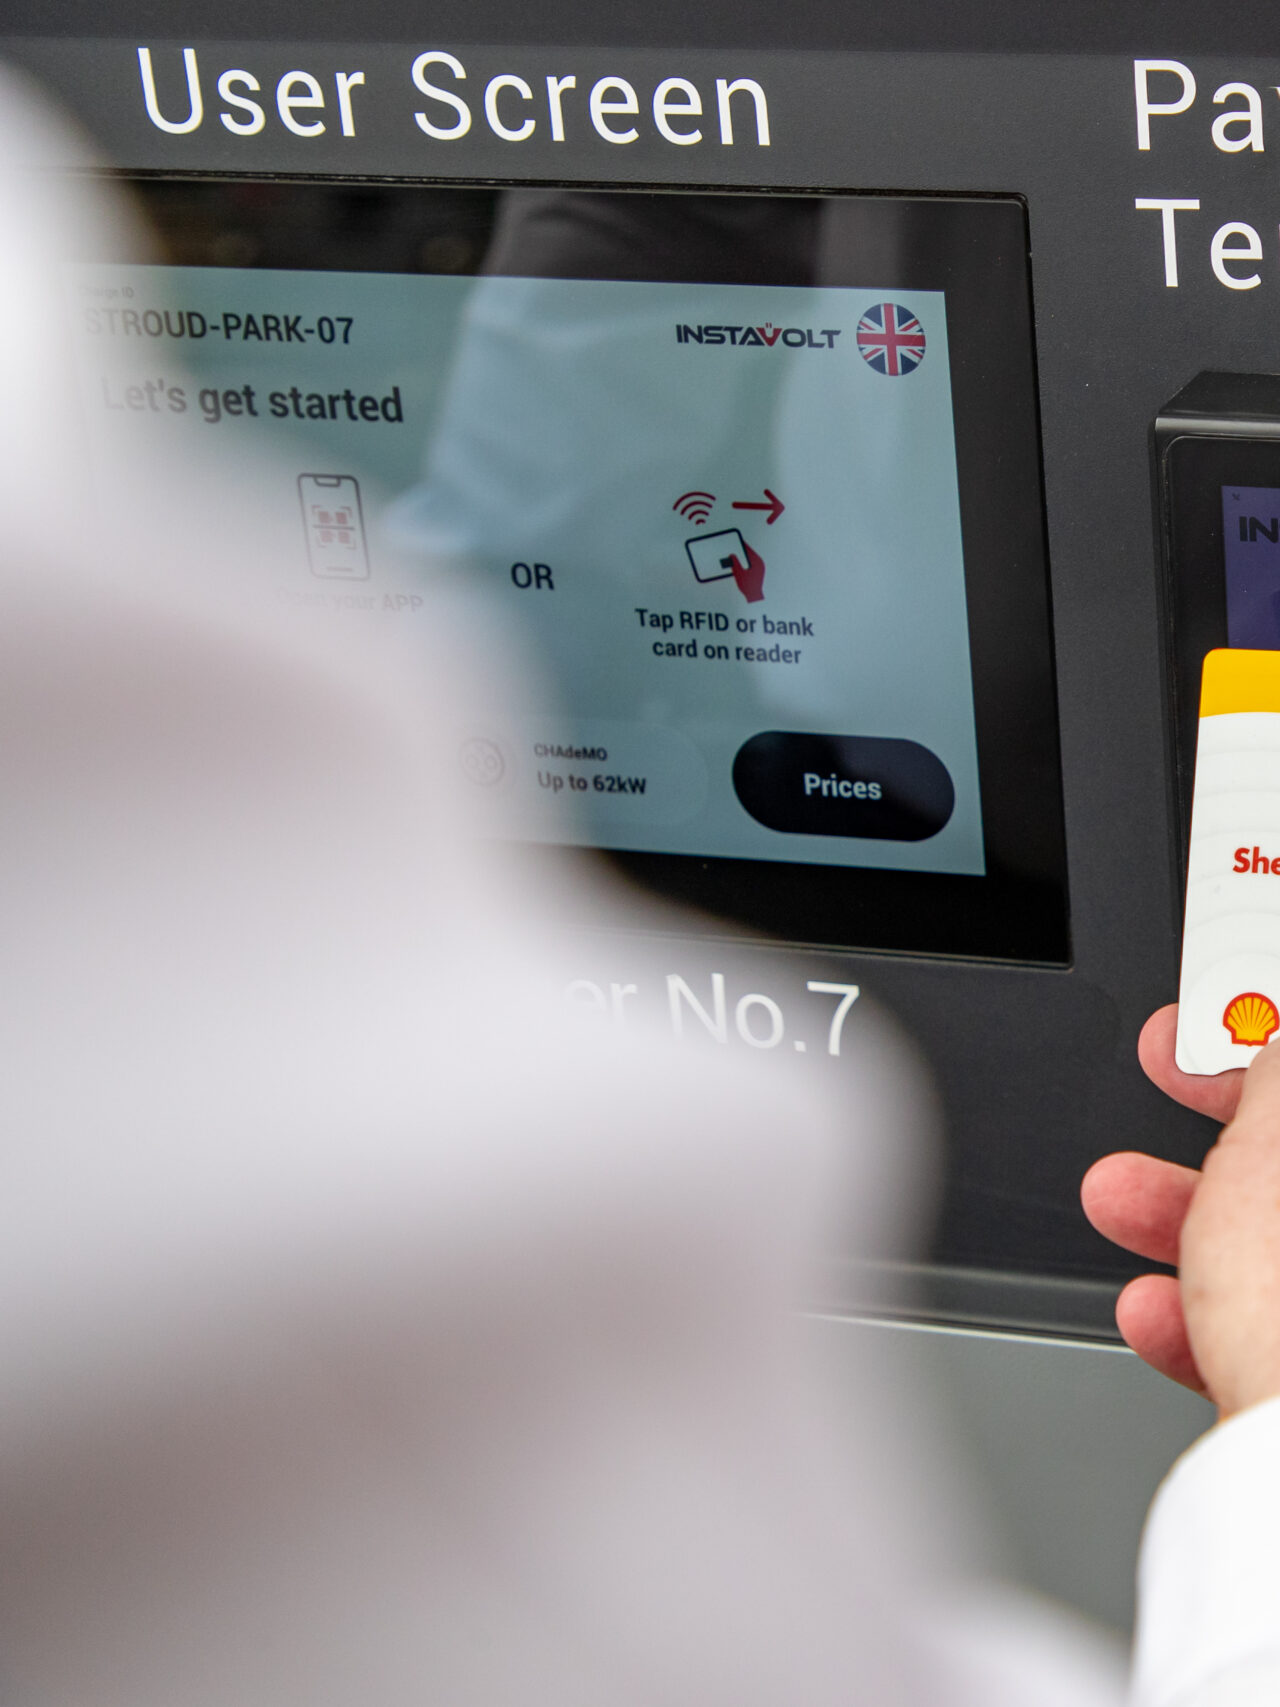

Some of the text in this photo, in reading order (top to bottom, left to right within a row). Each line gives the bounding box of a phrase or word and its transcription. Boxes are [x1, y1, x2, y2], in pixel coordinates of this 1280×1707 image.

[137, 48, 772, 146] User Screen
[85, 308, 354, 345] STROUD-PARK-07
[675, 322, 843, 349] INSTAVOLT
[199, 384, 259, 424] get
[268, 386, 404, 423] started
[510, 562, 556, 592] OR
[634, 607, 815, 637] Tap RFID or bank
[652, 638, 803, 664] card on reader
[533, 743, 609, 761] CHAdeMO
[537, 770, 647, 795] Up to 62kW
[803, 772, 883, 801] Prices
